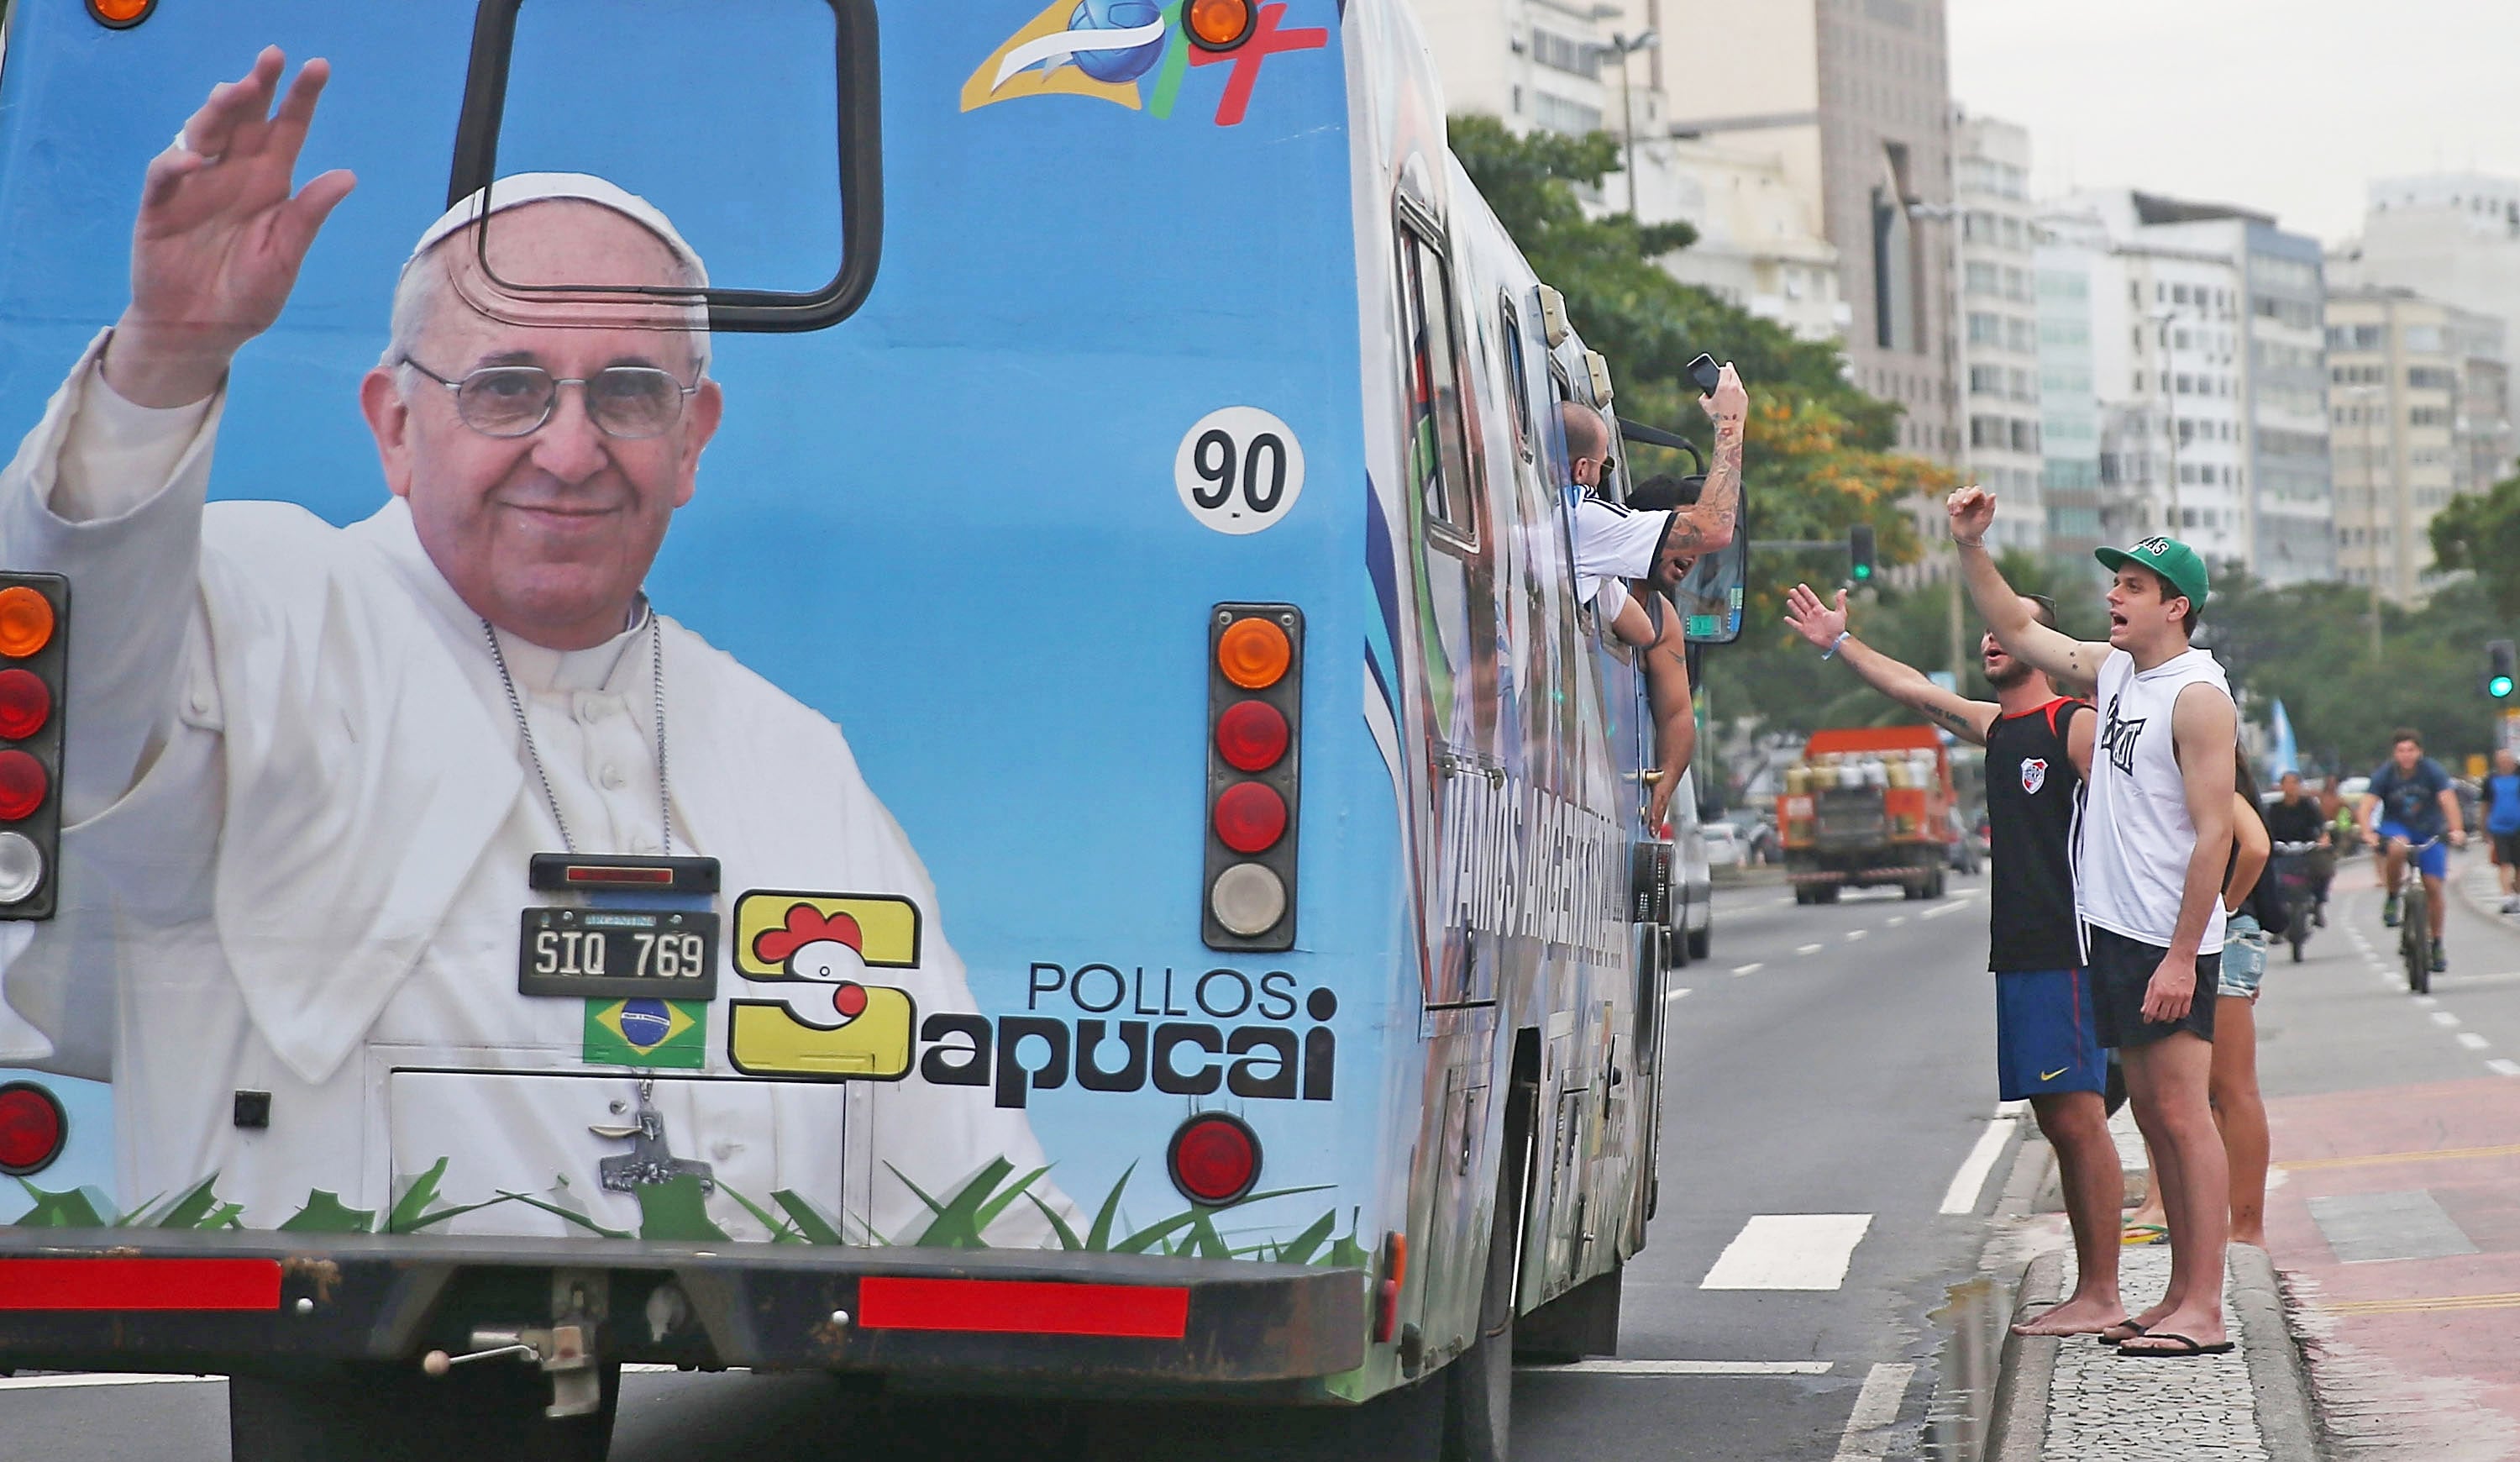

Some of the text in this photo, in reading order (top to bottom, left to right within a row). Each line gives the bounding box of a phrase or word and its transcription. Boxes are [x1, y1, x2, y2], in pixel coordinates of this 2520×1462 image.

[1192, 429, 1288, 513] 90
[535, 930, 704, 978] SIQ 769
[1028, 962, 1299, 1020] POLLOS
